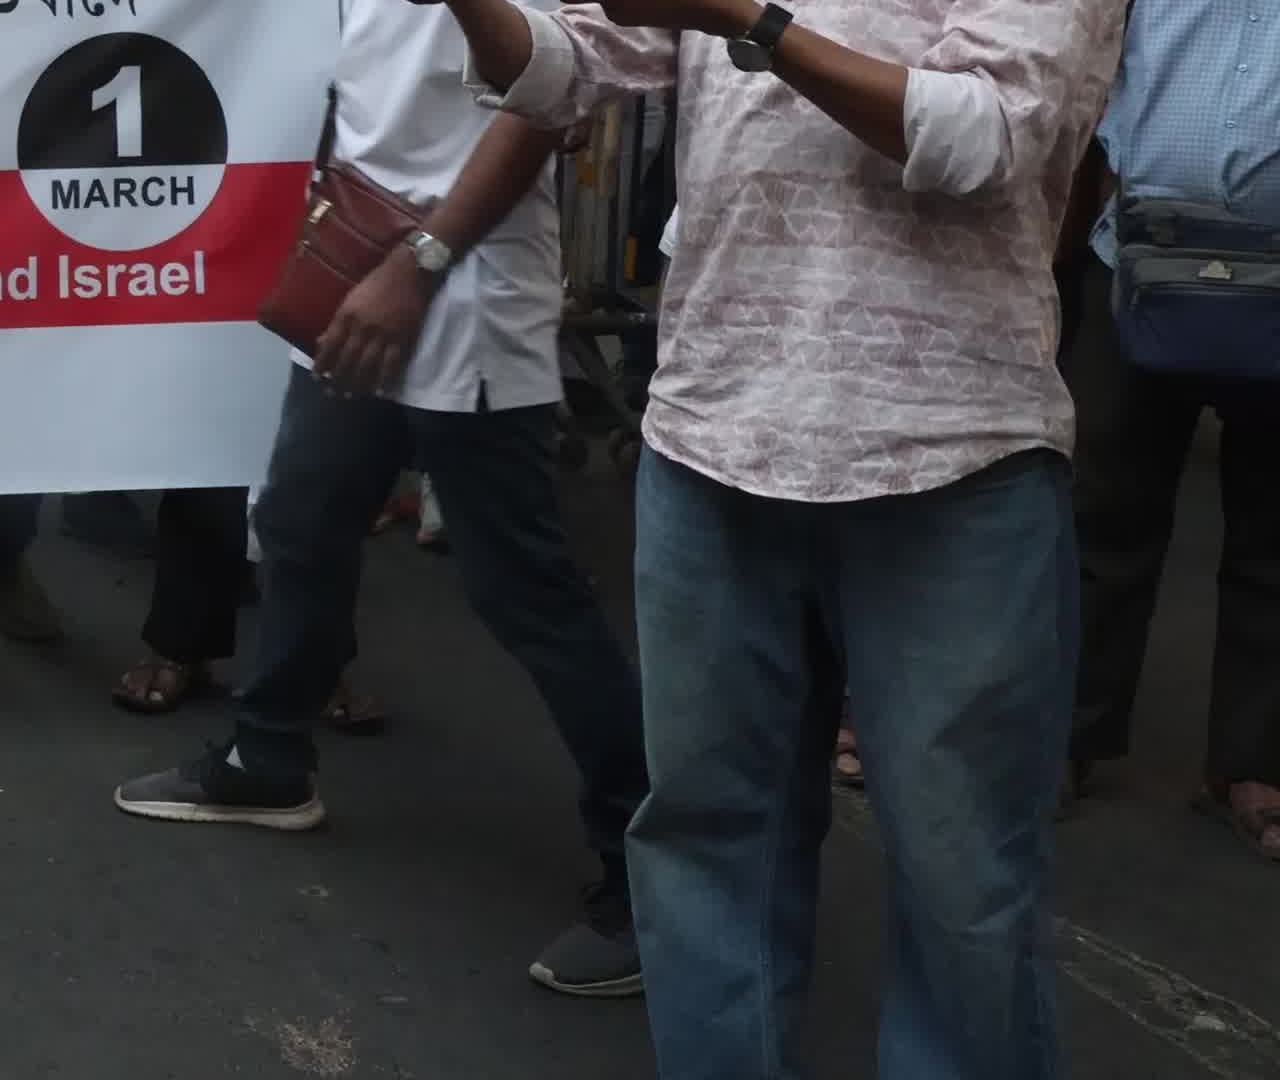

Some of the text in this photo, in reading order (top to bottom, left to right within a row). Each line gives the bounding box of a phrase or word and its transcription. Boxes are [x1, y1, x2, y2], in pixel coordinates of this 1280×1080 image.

[91, 65, 143, 159] 1
[51, 176, 196, 210] MARCH
[58, 251, 207, 300] Israel
